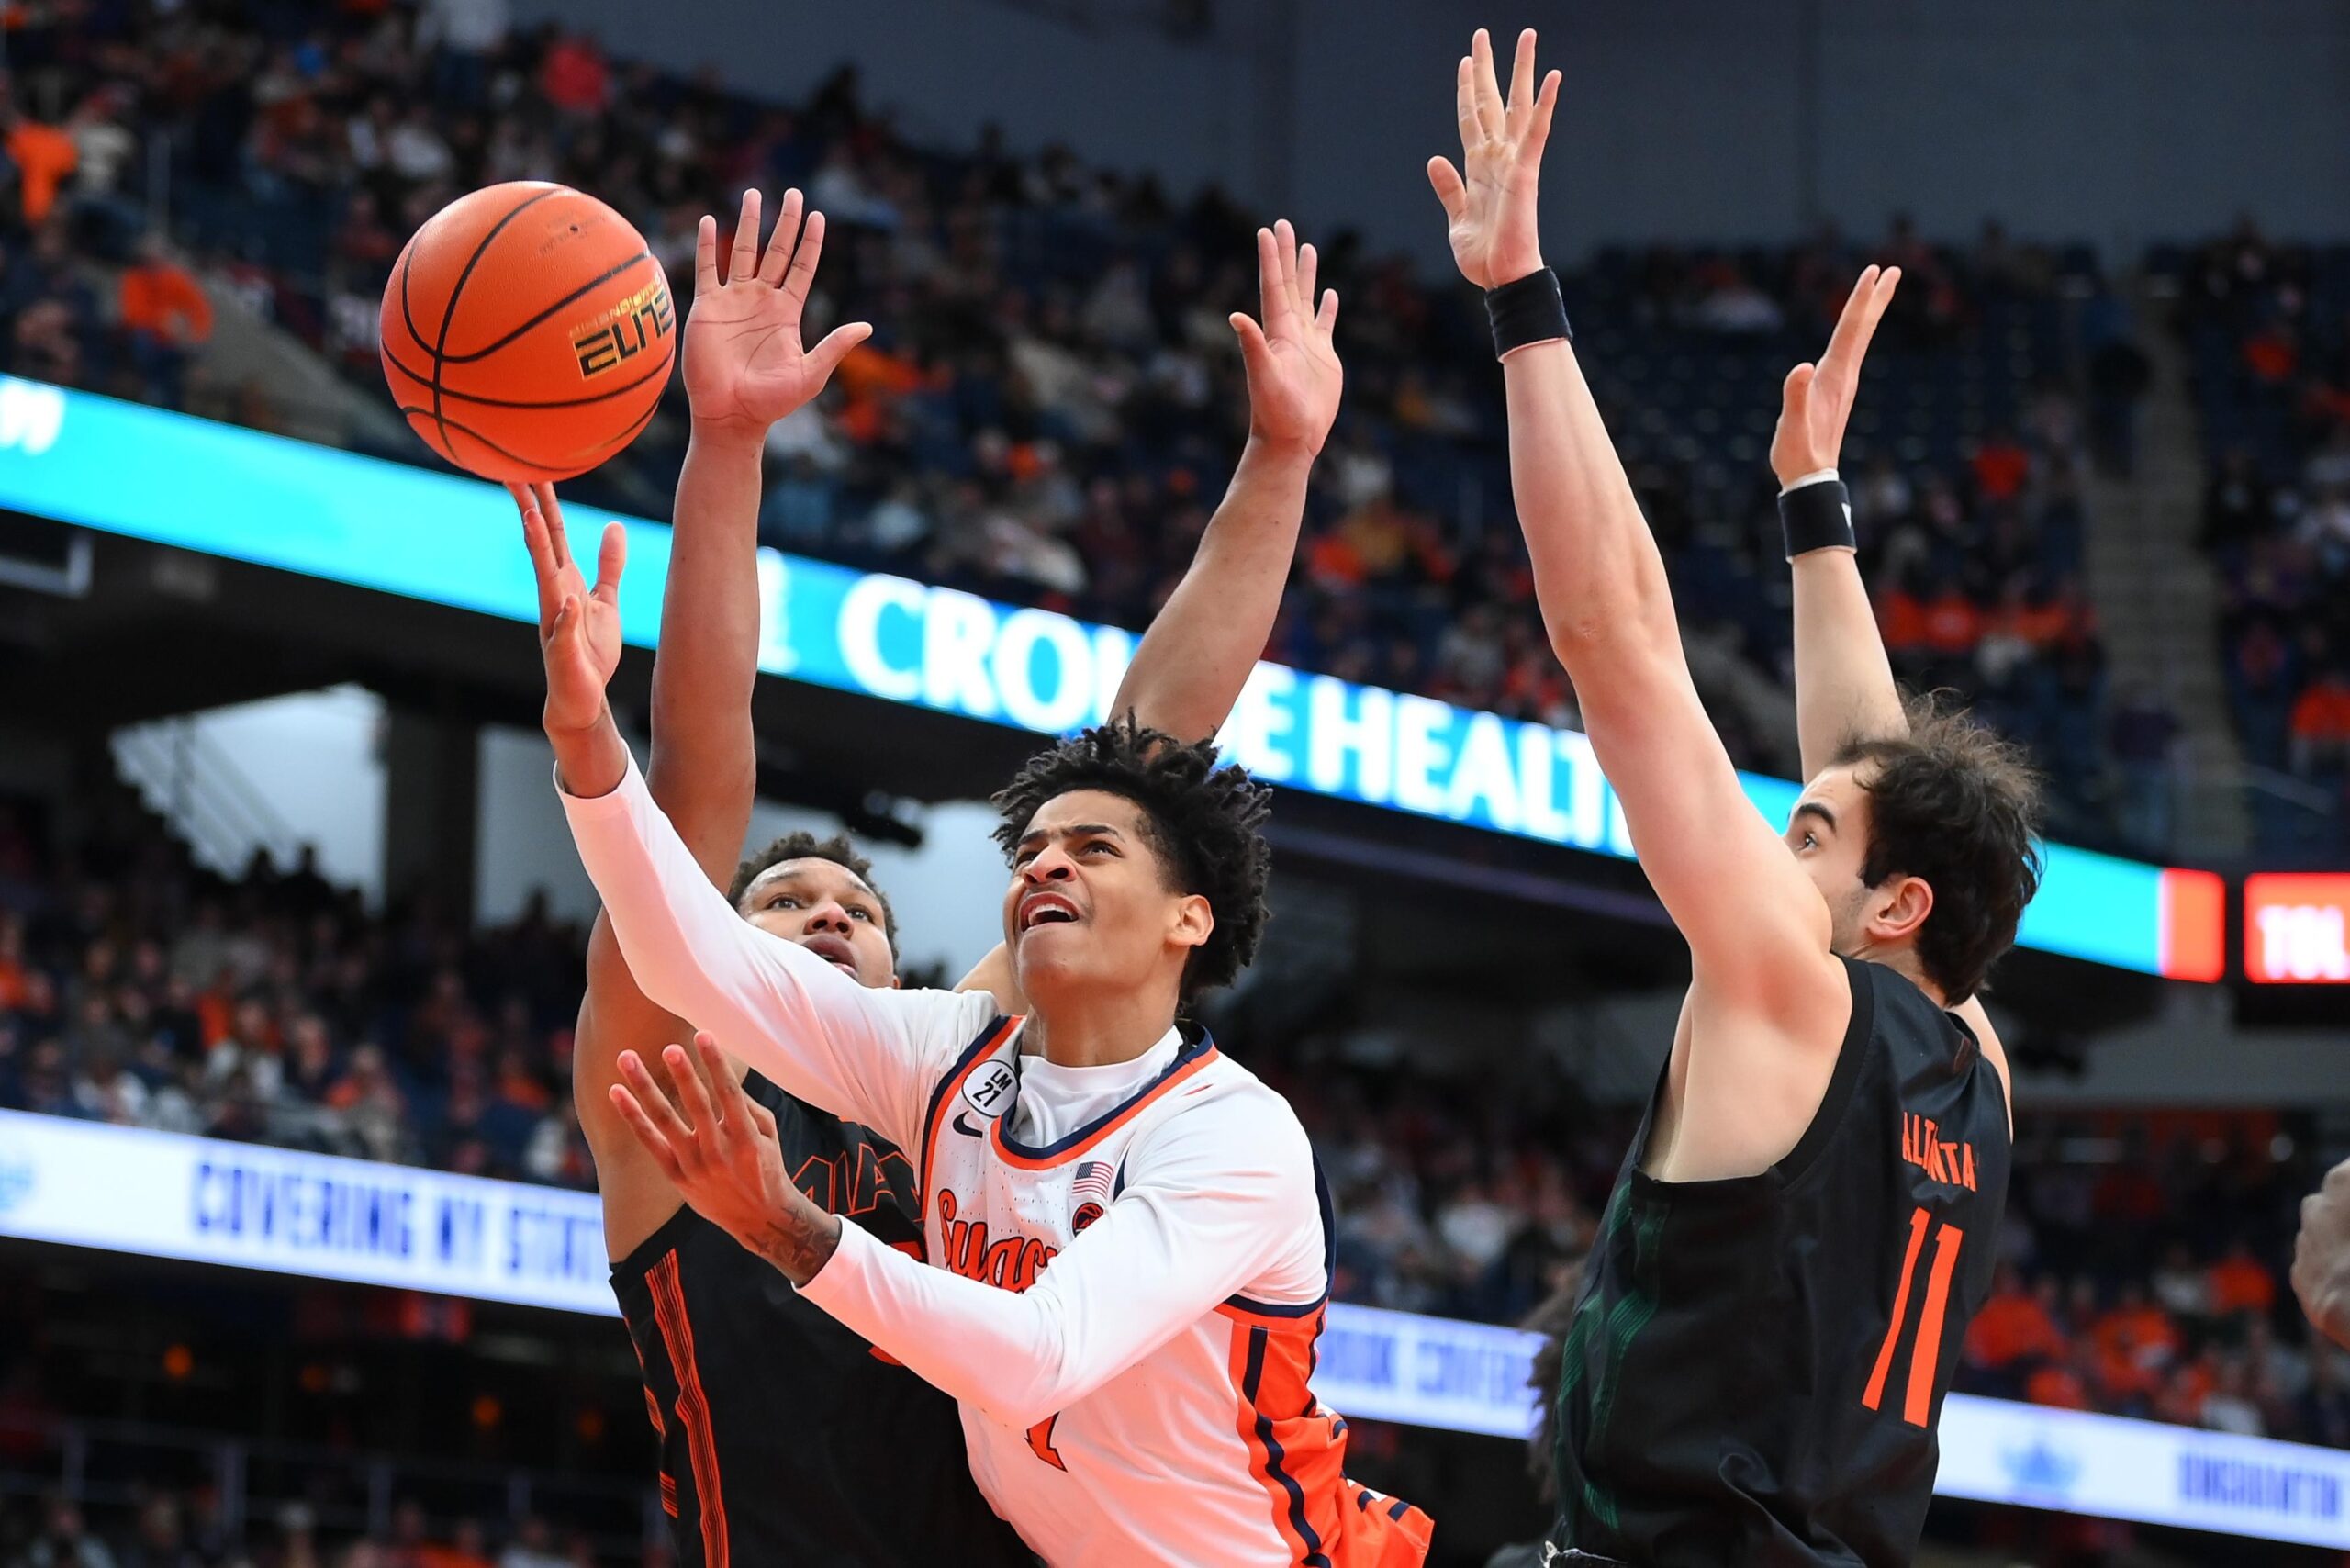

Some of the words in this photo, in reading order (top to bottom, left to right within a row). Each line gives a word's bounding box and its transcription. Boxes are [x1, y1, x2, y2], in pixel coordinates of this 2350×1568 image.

[573, 286, 674, 380] ELITE
[972, 1081, 1002, 1108] 21
[990, 1067, 1013, 1092] LM
[1862, 1206, 1964, 1428] 11
